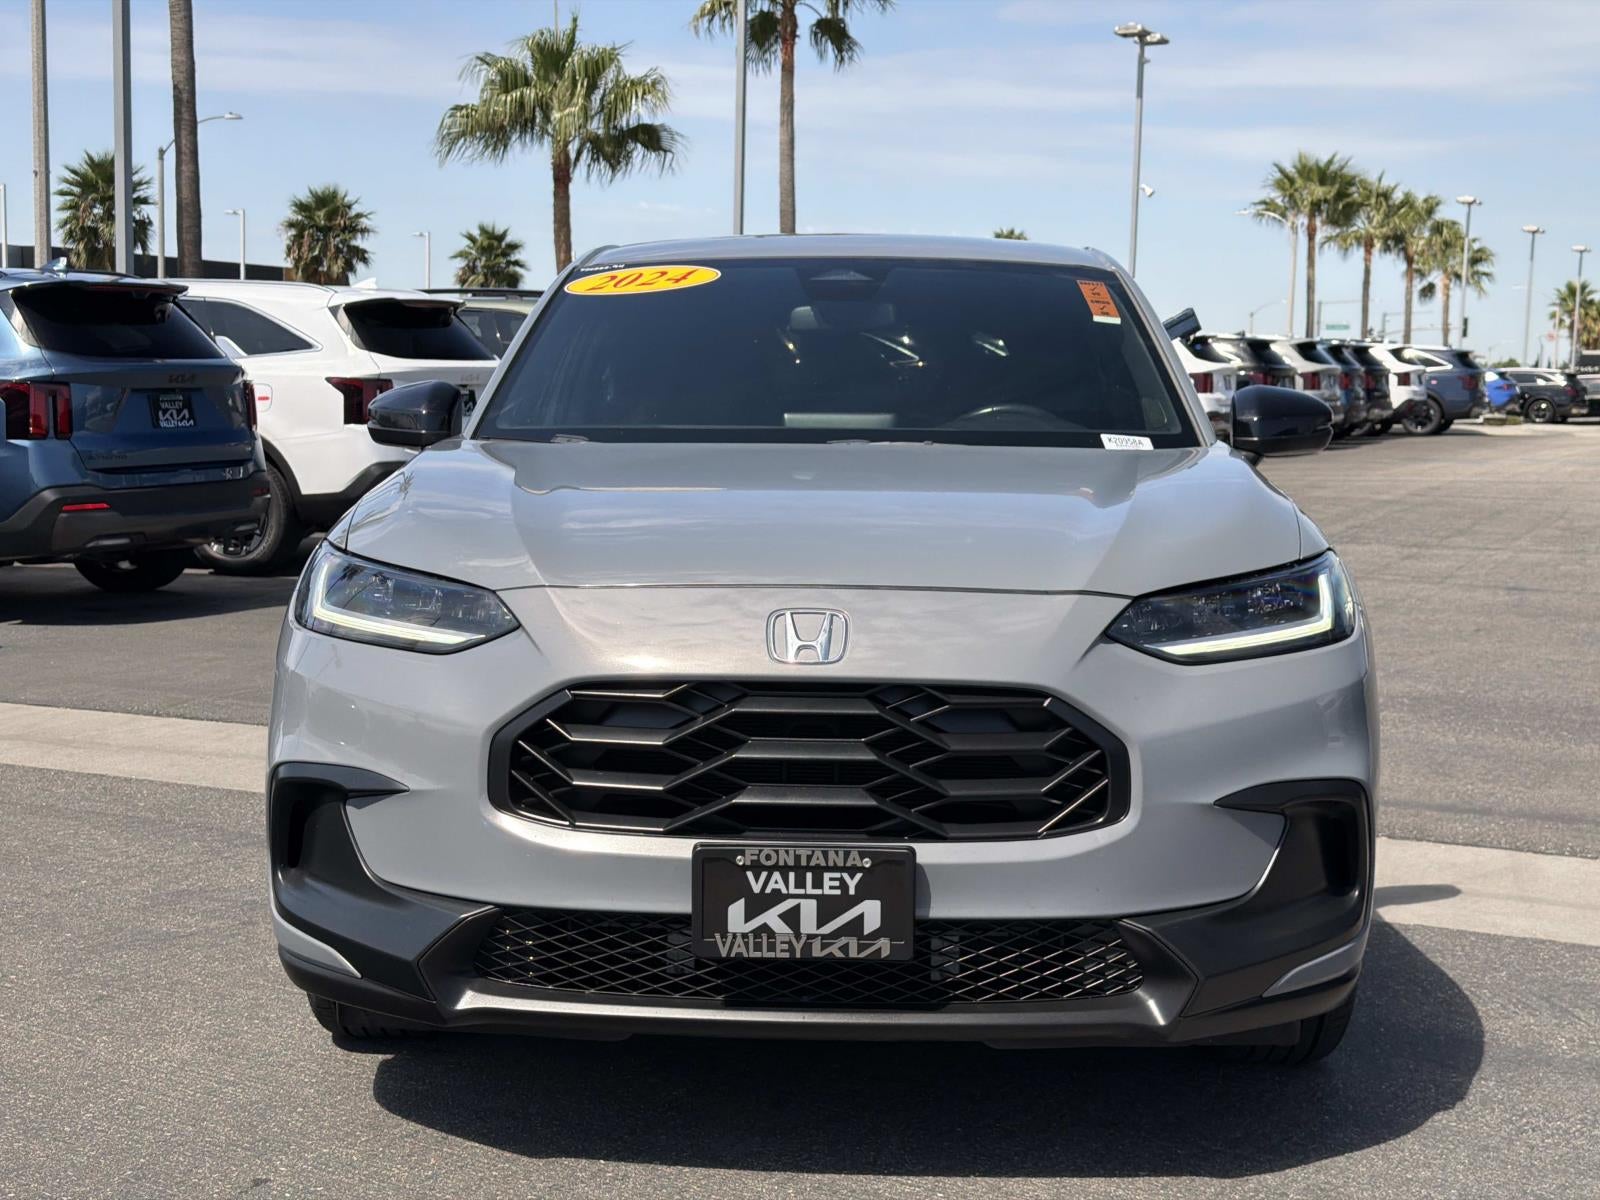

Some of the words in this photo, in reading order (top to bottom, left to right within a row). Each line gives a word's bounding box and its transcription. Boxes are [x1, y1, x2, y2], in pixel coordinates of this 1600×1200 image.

[585, 269, 699, 291] 2024
[159, 408, 190, 421] KIA
[744, 849, 863, 866] FONTANA
[746, 871, 863, 895] VALLEY
[727, 897, 882, 936] KIA
[714, 933, 808, 958] VALLEY
[810, 936, 891, 958] KIA
